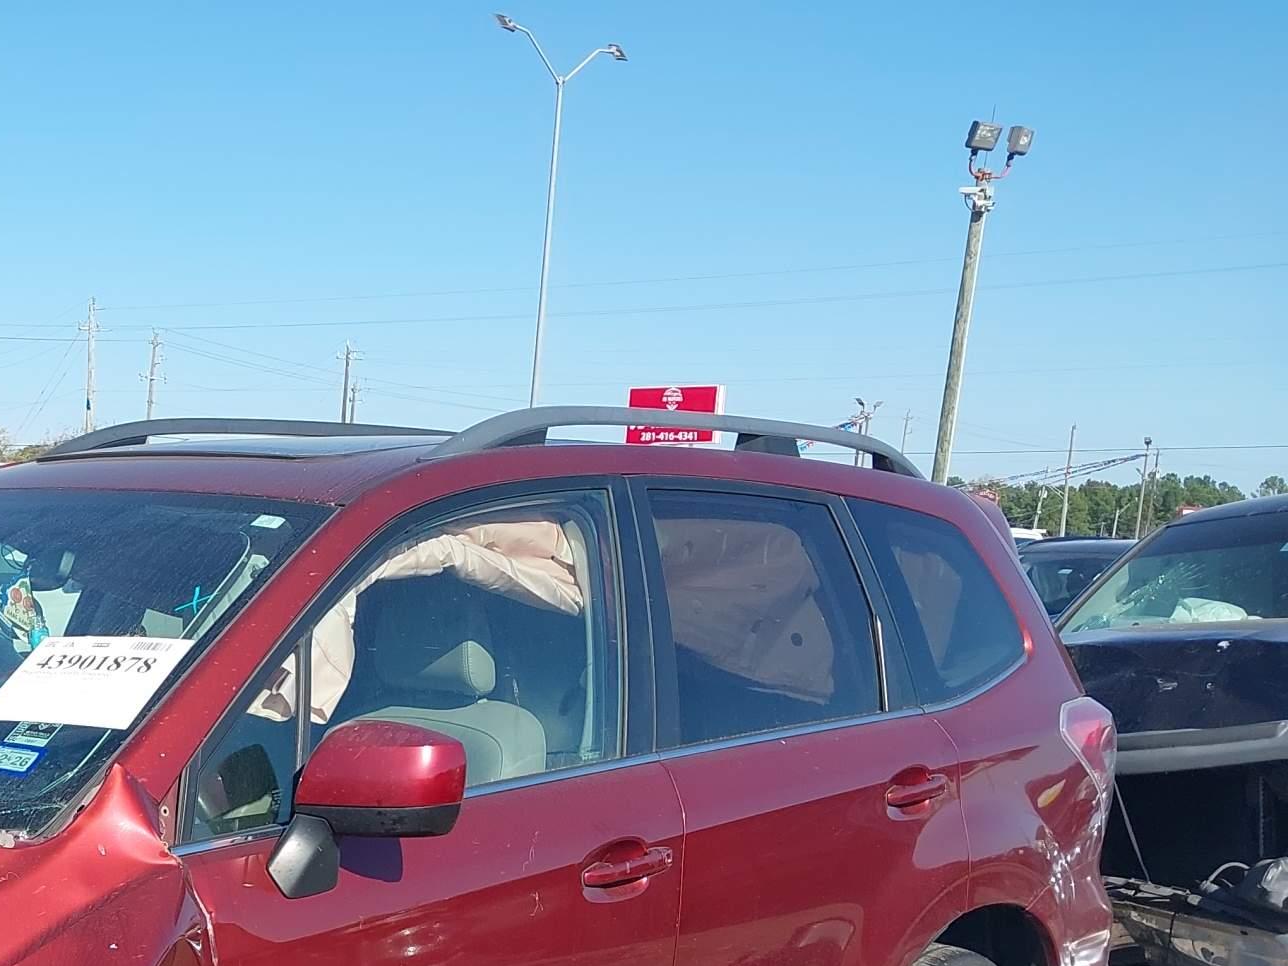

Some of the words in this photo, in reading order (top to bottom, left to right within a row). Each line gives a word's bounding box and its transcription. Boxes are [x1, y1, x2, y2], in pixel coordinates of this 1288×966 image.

[640, 431, 698, 442] 281-416-4341
[36, 654, 158, 673] 43901878
[11, 755, 32, 767] 26
